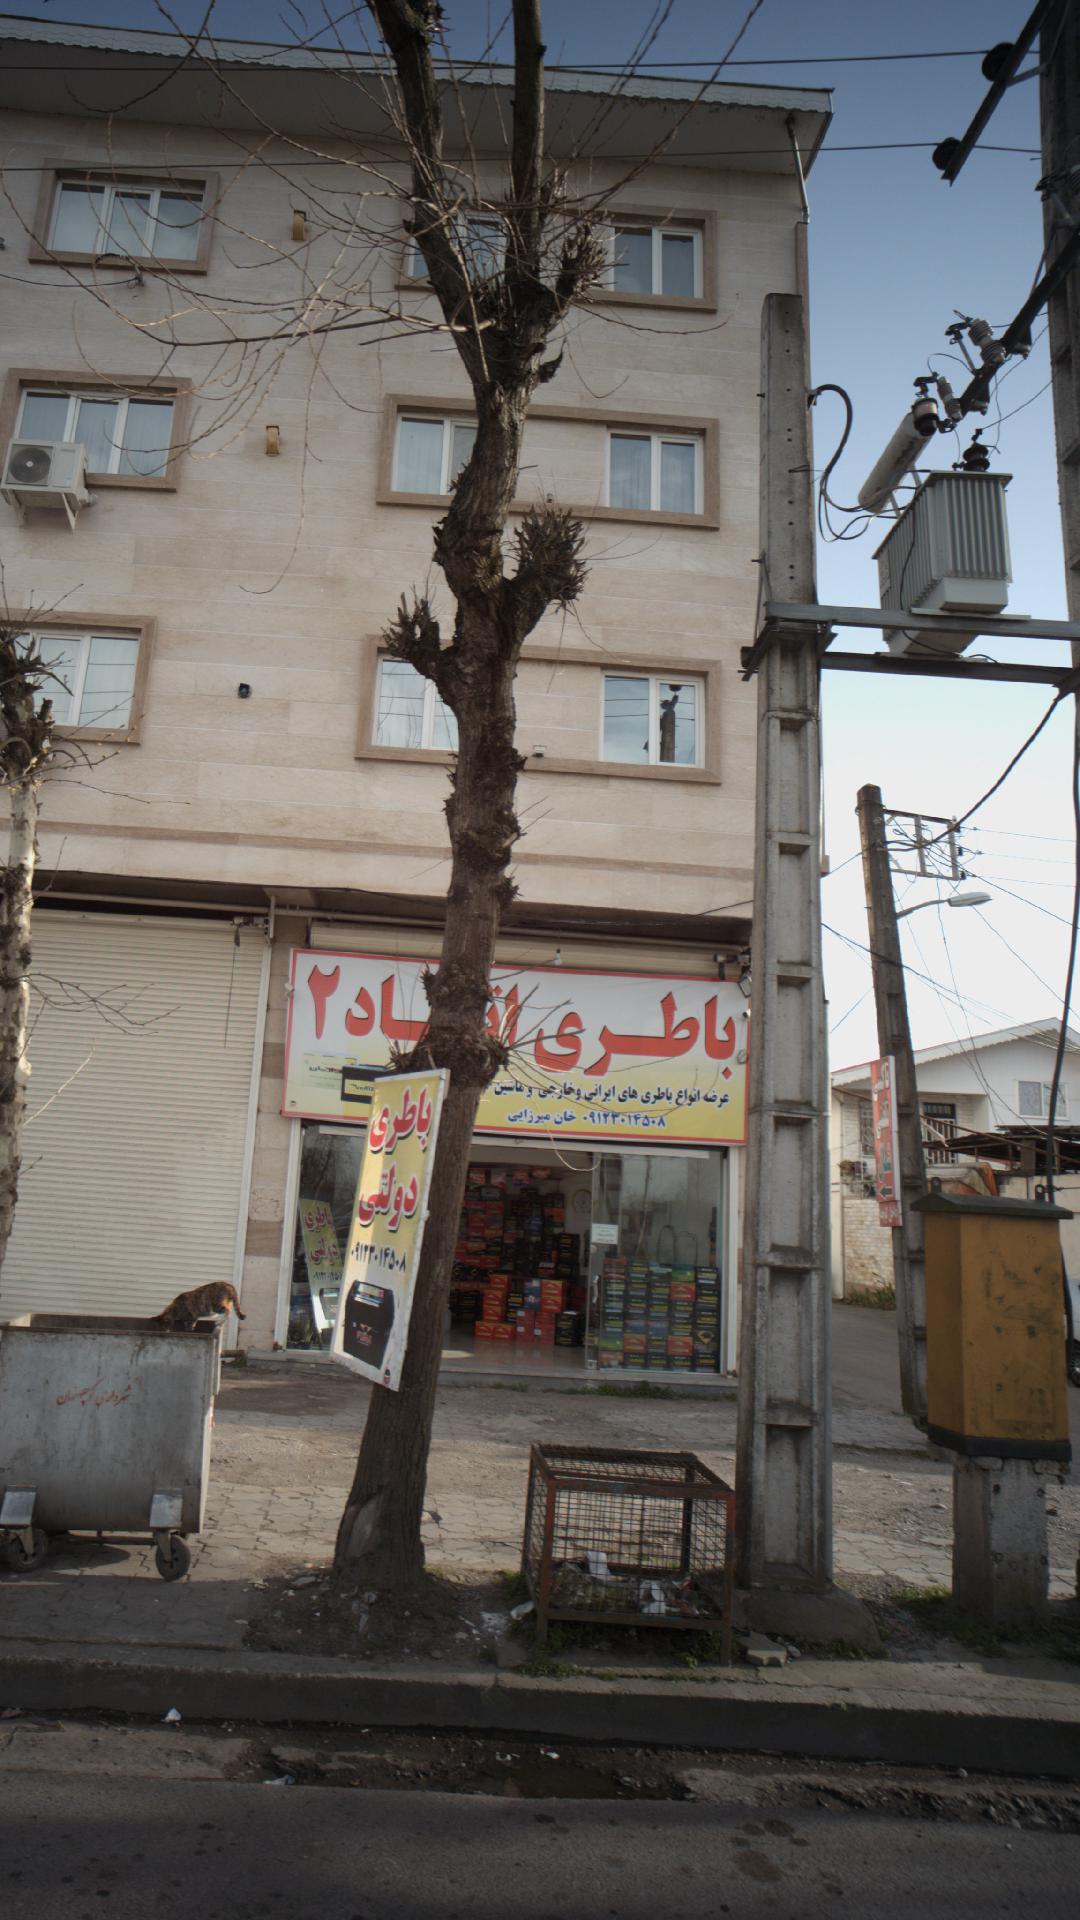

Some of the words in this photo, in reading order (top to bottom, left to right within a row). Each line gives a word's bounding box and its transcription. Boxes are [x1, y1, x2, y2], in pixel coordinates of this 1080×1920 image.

[307, 964, 341, 1040] ۲
[344, 974, 520, 1047] اتاد
[534, 991, 735, 1080] باطری
[585, 1084, 615, 1102] ایرانی
[618, 1086, 638, 1102] های
[641, 1087, 672, 1104] باطری
[674, 1088, 700, 1106] انواع
[702, 1090, 729, 1108] عرضه
[369, 1087, 432, 1150] باطری
[507, 1109, 551, 1124] میرزایی
[553, 1110, 576, 1124] خان
[583, 1111, 666, 1127] ۰۹۱۲۳۰۱۴۵۰۸
[359, 1164, 418, 1228] دولتی
